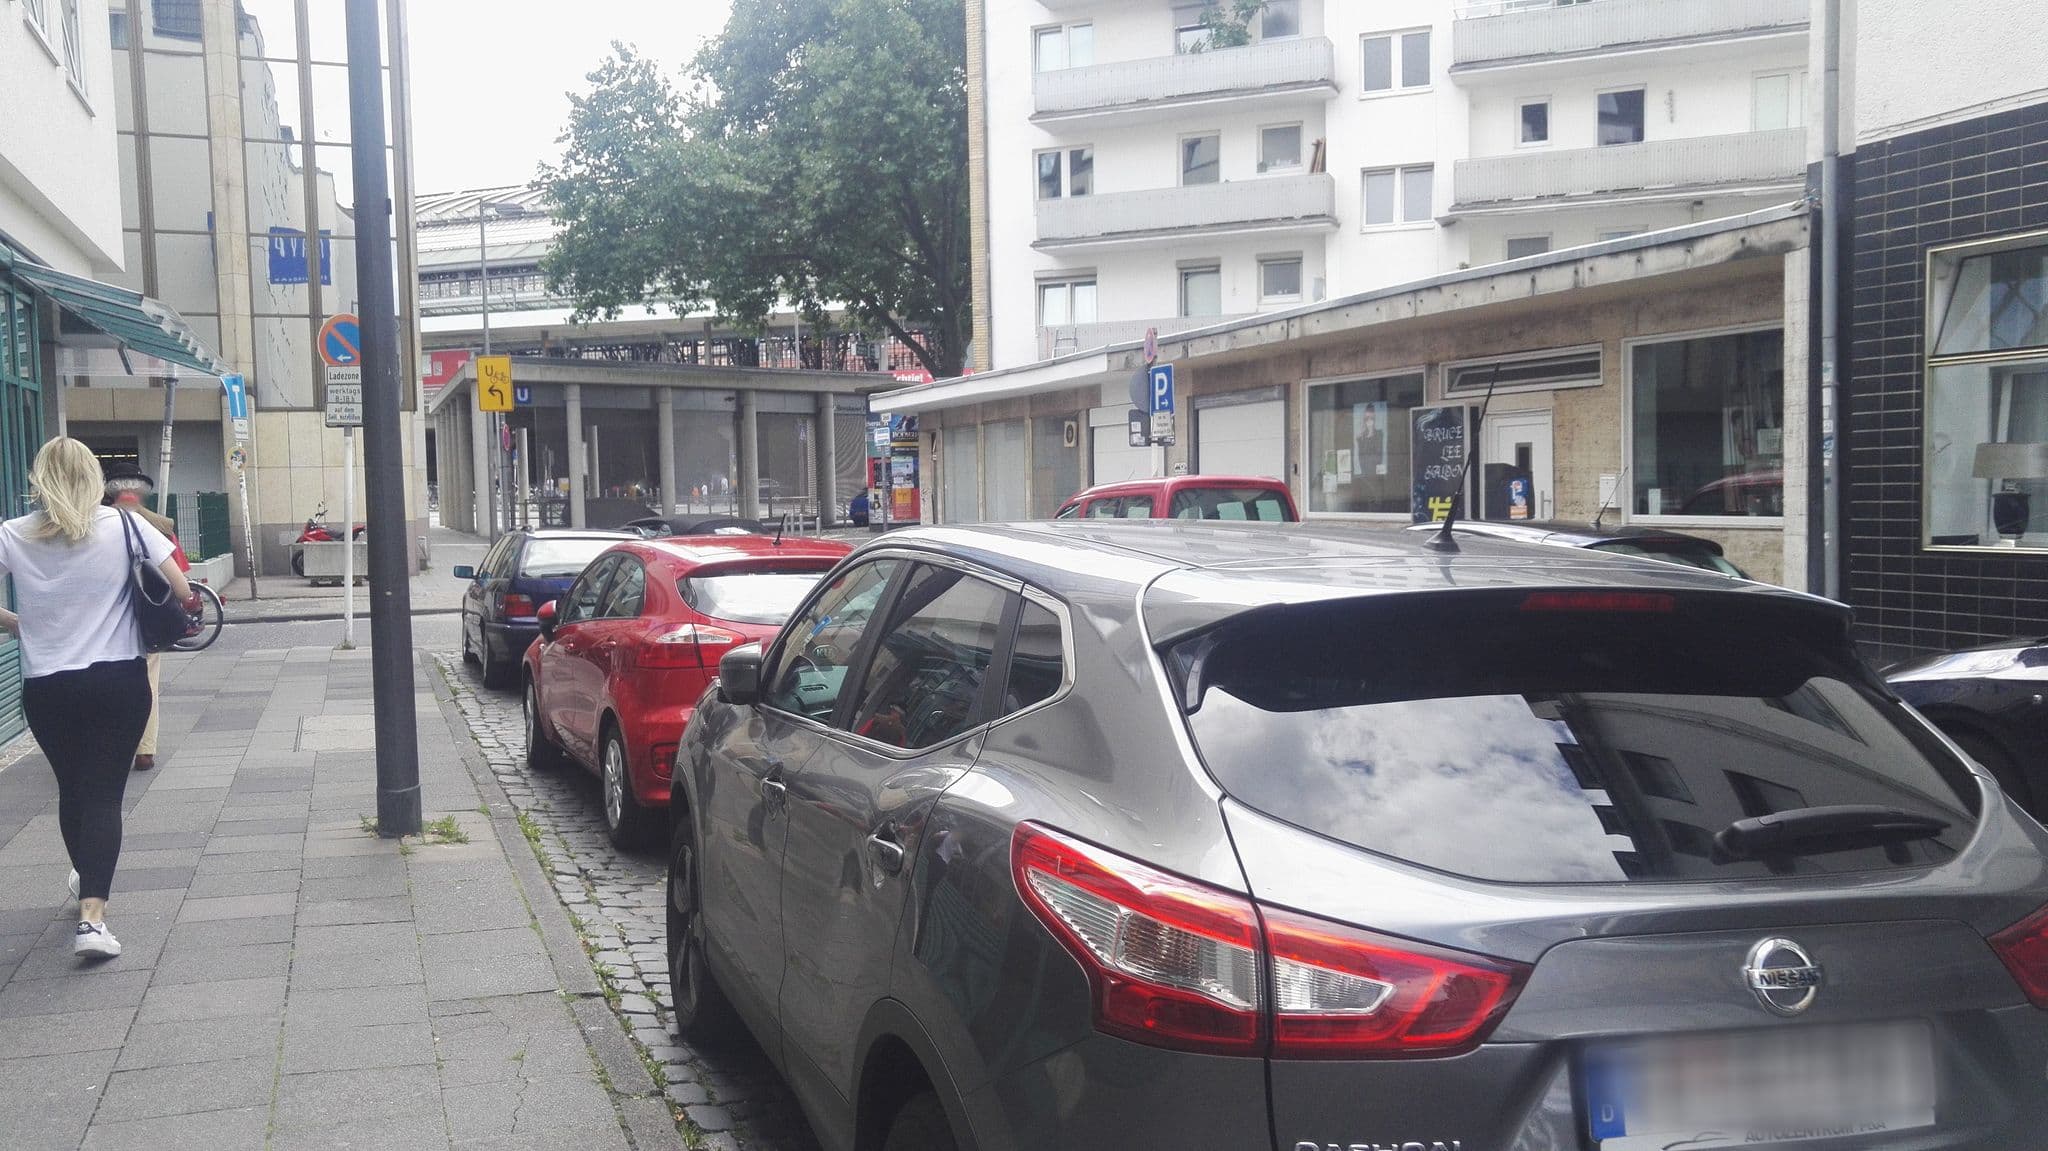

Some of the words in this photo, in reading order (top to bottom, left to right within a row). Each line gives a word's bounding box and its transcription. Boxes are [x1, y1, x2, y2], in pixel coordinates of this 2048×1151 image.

[328, 371, 360, 380] Ladezone
[484, 365, 494, 377] U
[329, 387, 361, 397] werktags
[516, 387, 529, 401] U
[1154, 372, 1168, 410] P
[1424, 425, 1463, 442] BRUCE
[1440, 445, 1462, 461] LEE
[1424, 464, 1464, 480] SALOON
[1760, 969, 1818, 986] NISSAN
